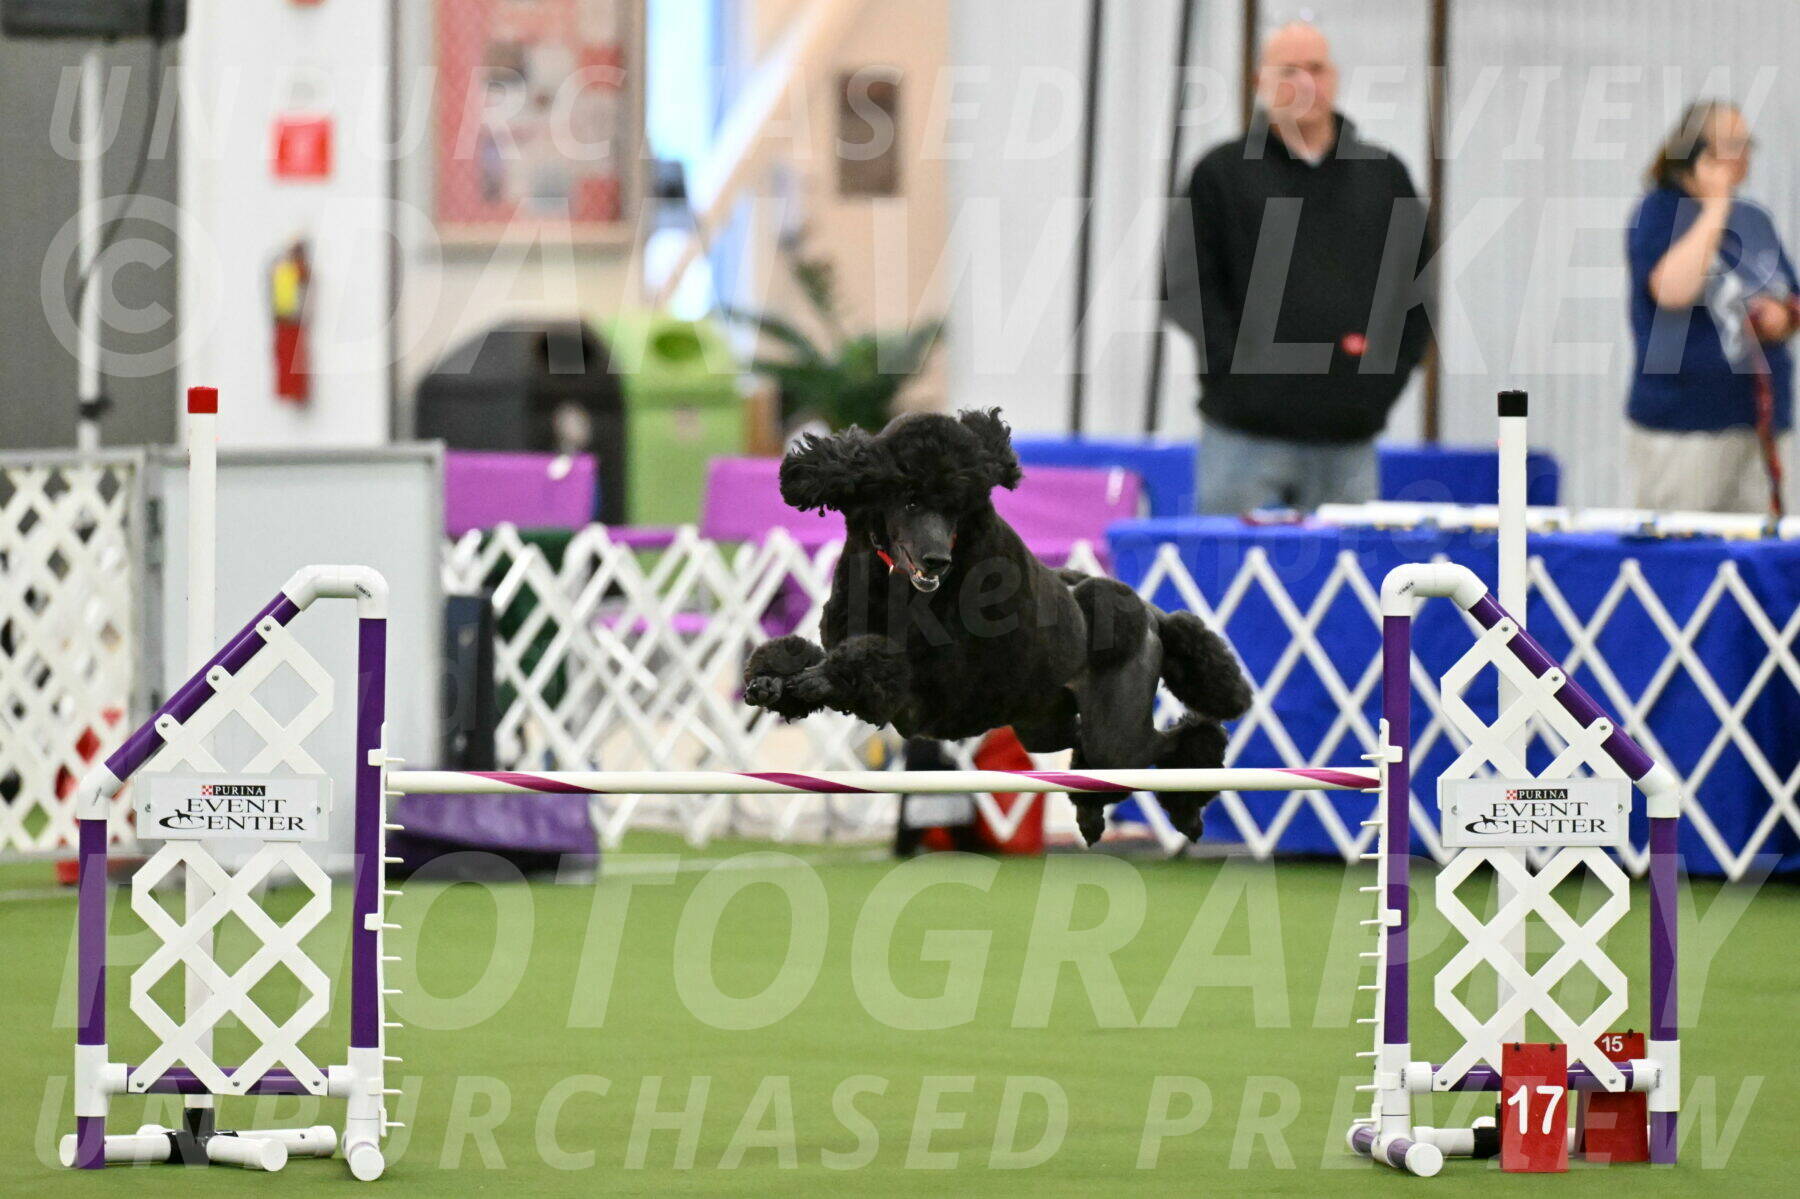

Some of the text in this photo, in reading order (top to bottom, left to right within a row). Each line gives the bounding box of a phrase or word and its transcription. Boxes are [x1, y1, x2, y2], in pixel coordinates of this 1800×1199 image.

[215, 786, 265, 796] PURINA
[1518, 790, 1567, 799] PURINA
[186, 798, 287, 814] EVENT
[1491, 802, 1589, 818] EVENT
[158, 815, 307, 831] CENTER
[1465, 818, 1607, 835] CENTER
[1601, 1035, 1624, 1053] 15
[1507, 1084, 1565, 1135] 17
